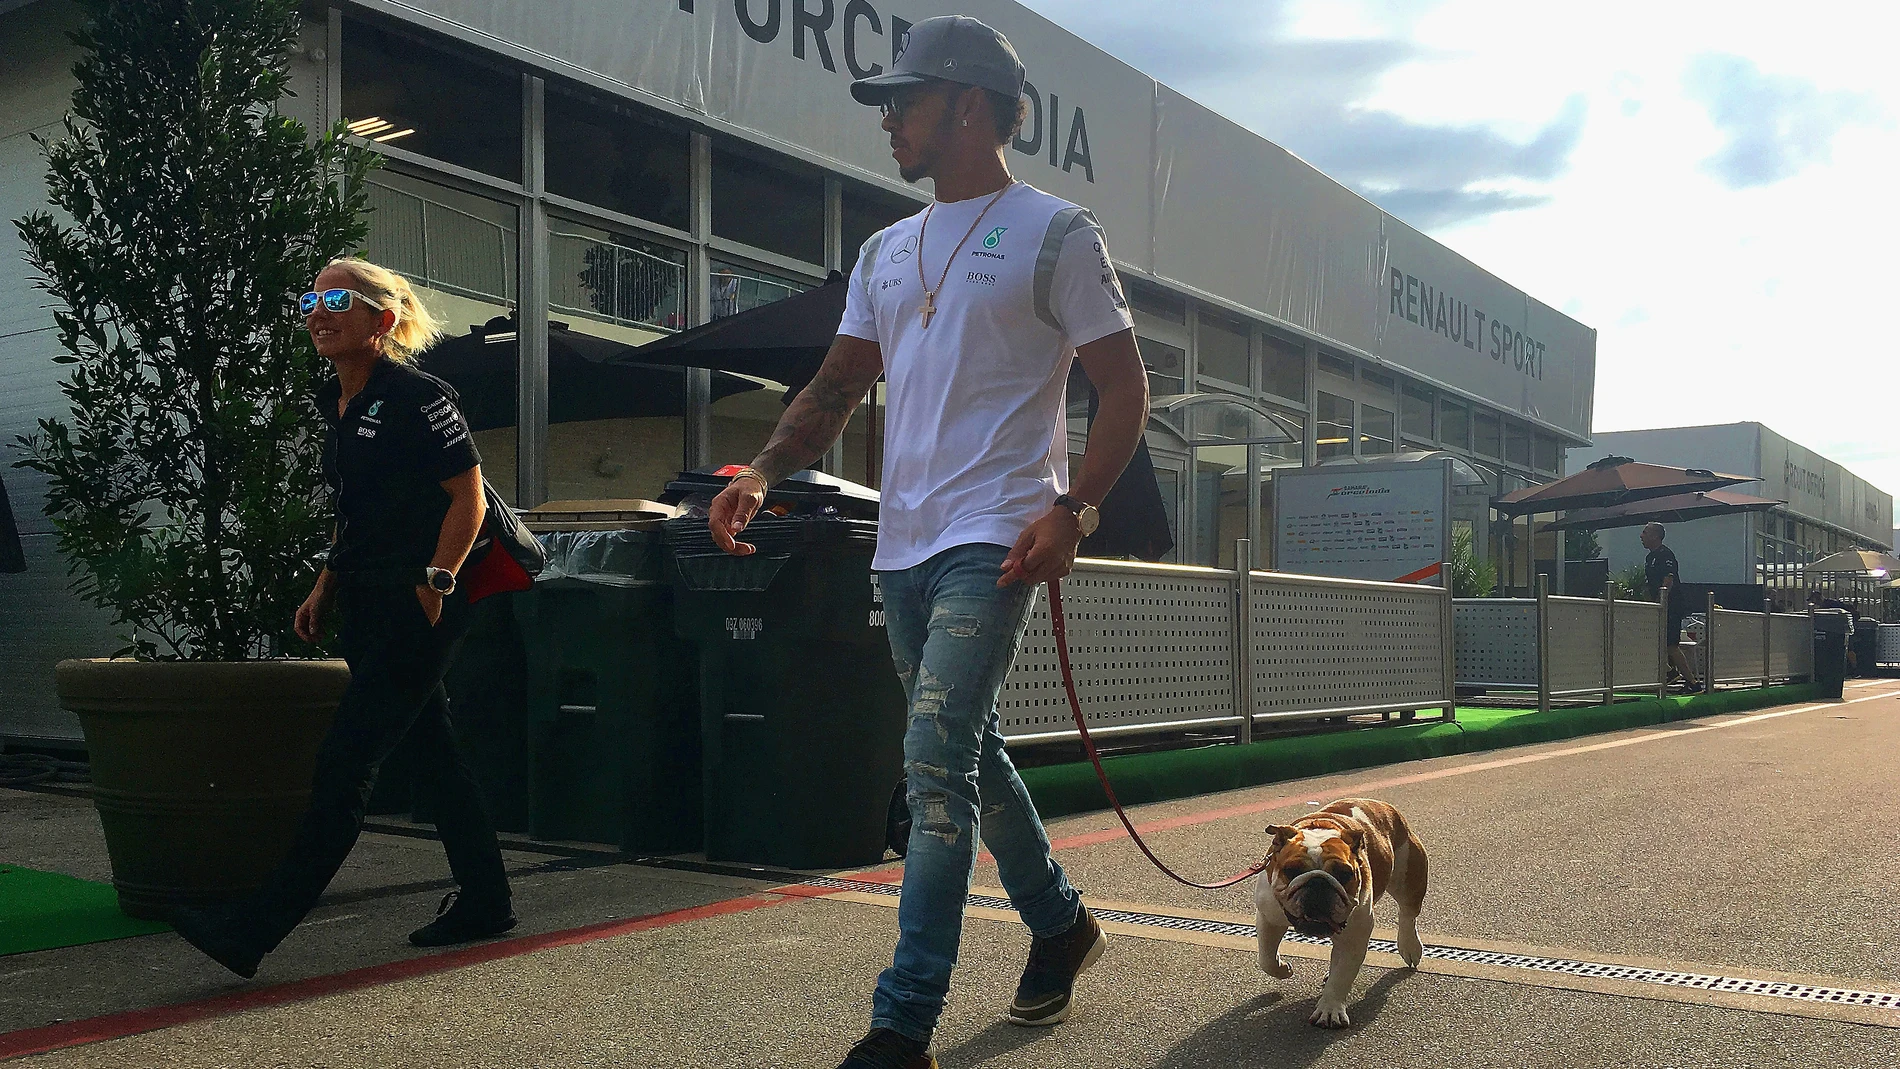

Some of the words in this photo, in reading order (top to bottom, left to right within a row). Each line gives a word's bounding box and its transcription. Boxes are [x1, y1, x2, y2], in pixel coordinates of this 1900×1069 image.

[1012, 80, 1096, 184] DIA
[971, 251, 1005, 260] PETRONAS
[889, 278, 902, 287] UBS
[967, 271, 997, 283] BOSS
[1390, 266, 1485, 353] RENAULT
[1490, 319, 1545, 381] SPORT
[427, 403, 453, 422] EPSON
[358, 426, 376, 436] BOSS
[442, 423, 460, 438] IWC
[868, 610, 885, 627] 800
